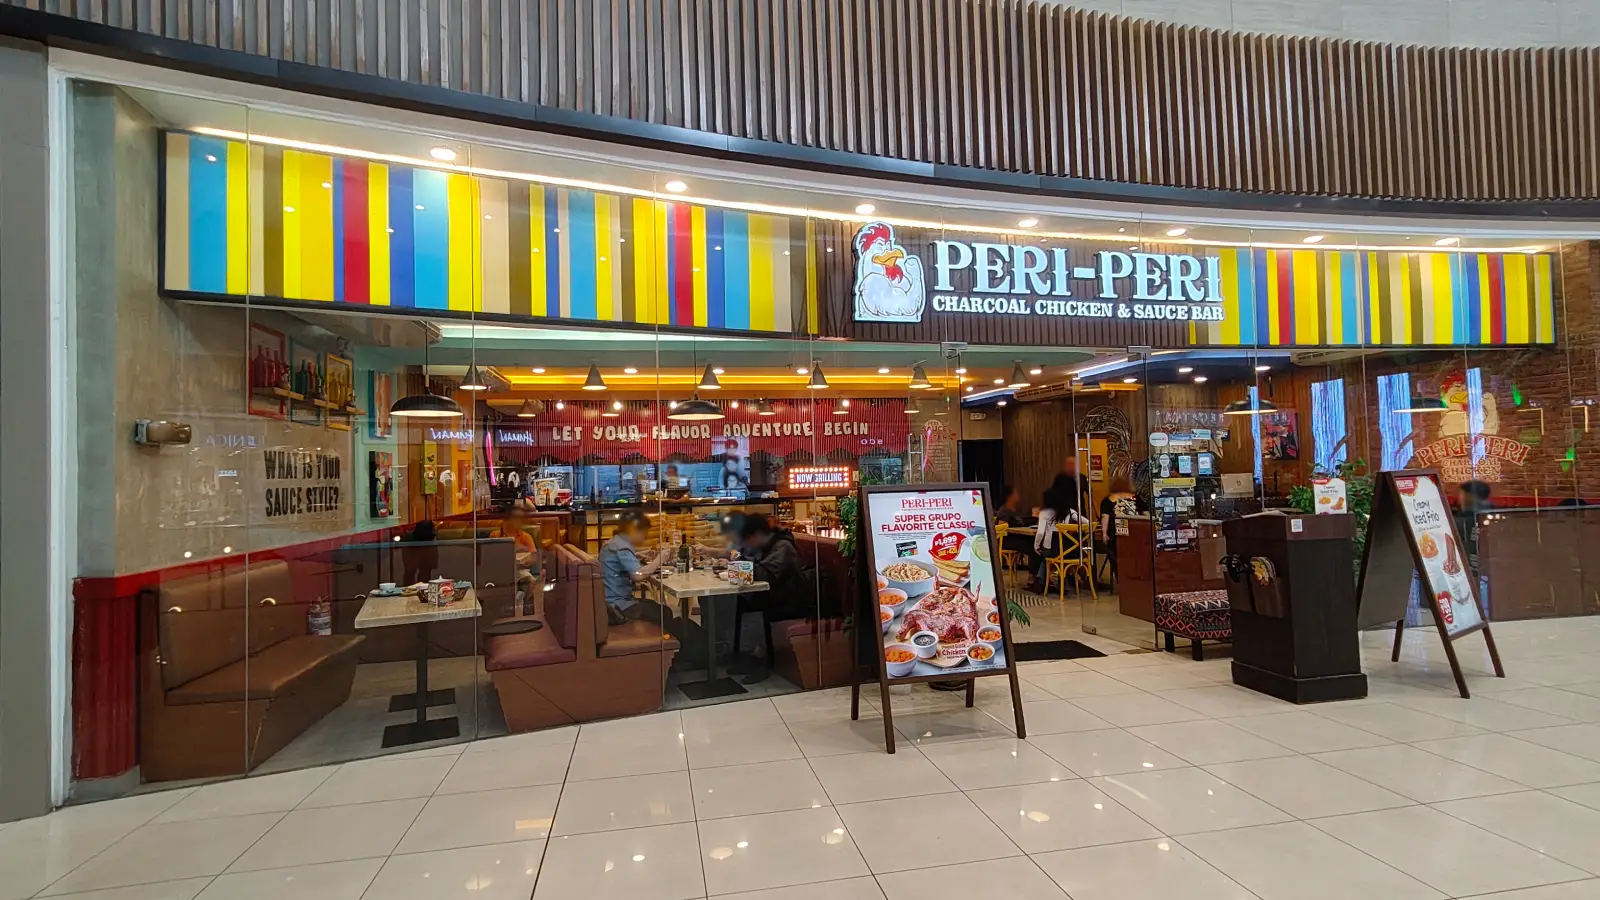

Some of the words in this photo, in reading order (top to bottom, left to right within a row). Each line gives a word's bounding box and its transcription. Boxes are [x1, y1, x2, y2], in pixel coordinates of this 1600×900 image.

[933, 239, 1223, 302] PERI-PERI
[932, 295, 1031, 315] CHARCOAL
[1034, 299, 1113, 318] CHICKEN
[1117, 302, 1132, 318] &
[1134, 304, 1189, 320] SAUCE
[1191, 306, 1225, 320] BAR
[552, 425, 582, 441] LET
[592, 424, 640, 441] YOUR
[652, 423, 711, 440] FLAVOR
[723, 421, 814, 438] ADVENTURE
[824, 420, 868, 436] BEGIN
[1415, 434, 1531, 468] PERI-PERI
[264, 450, 298, 480] WHAT
[302, 453, 313, 480] IS
[316, 454, 341, 480] YOUR
[1442, 458, 1501, 467] CHAROAL
[796, 473, 813, 484] NOW
[814, 472, 842, 483] GRILLING
[1441, 466, 1501, 476] CHICKEN
[265, 486, 303, 517] SAUCE
[306, 485, 340, 513] STYLE?
[901, 498, 952, 508] PERI-PERI
[894, 514, 926, 523] SUPER
[928, 512, 961, 522] GRUPO
[1412, 511, 1427, 524] Iced
[1426, 510, 1440, 523] Frio
[881, 523, 935, 533] FLAVORITE
[937, 520, 976, 530] CLASSIC
